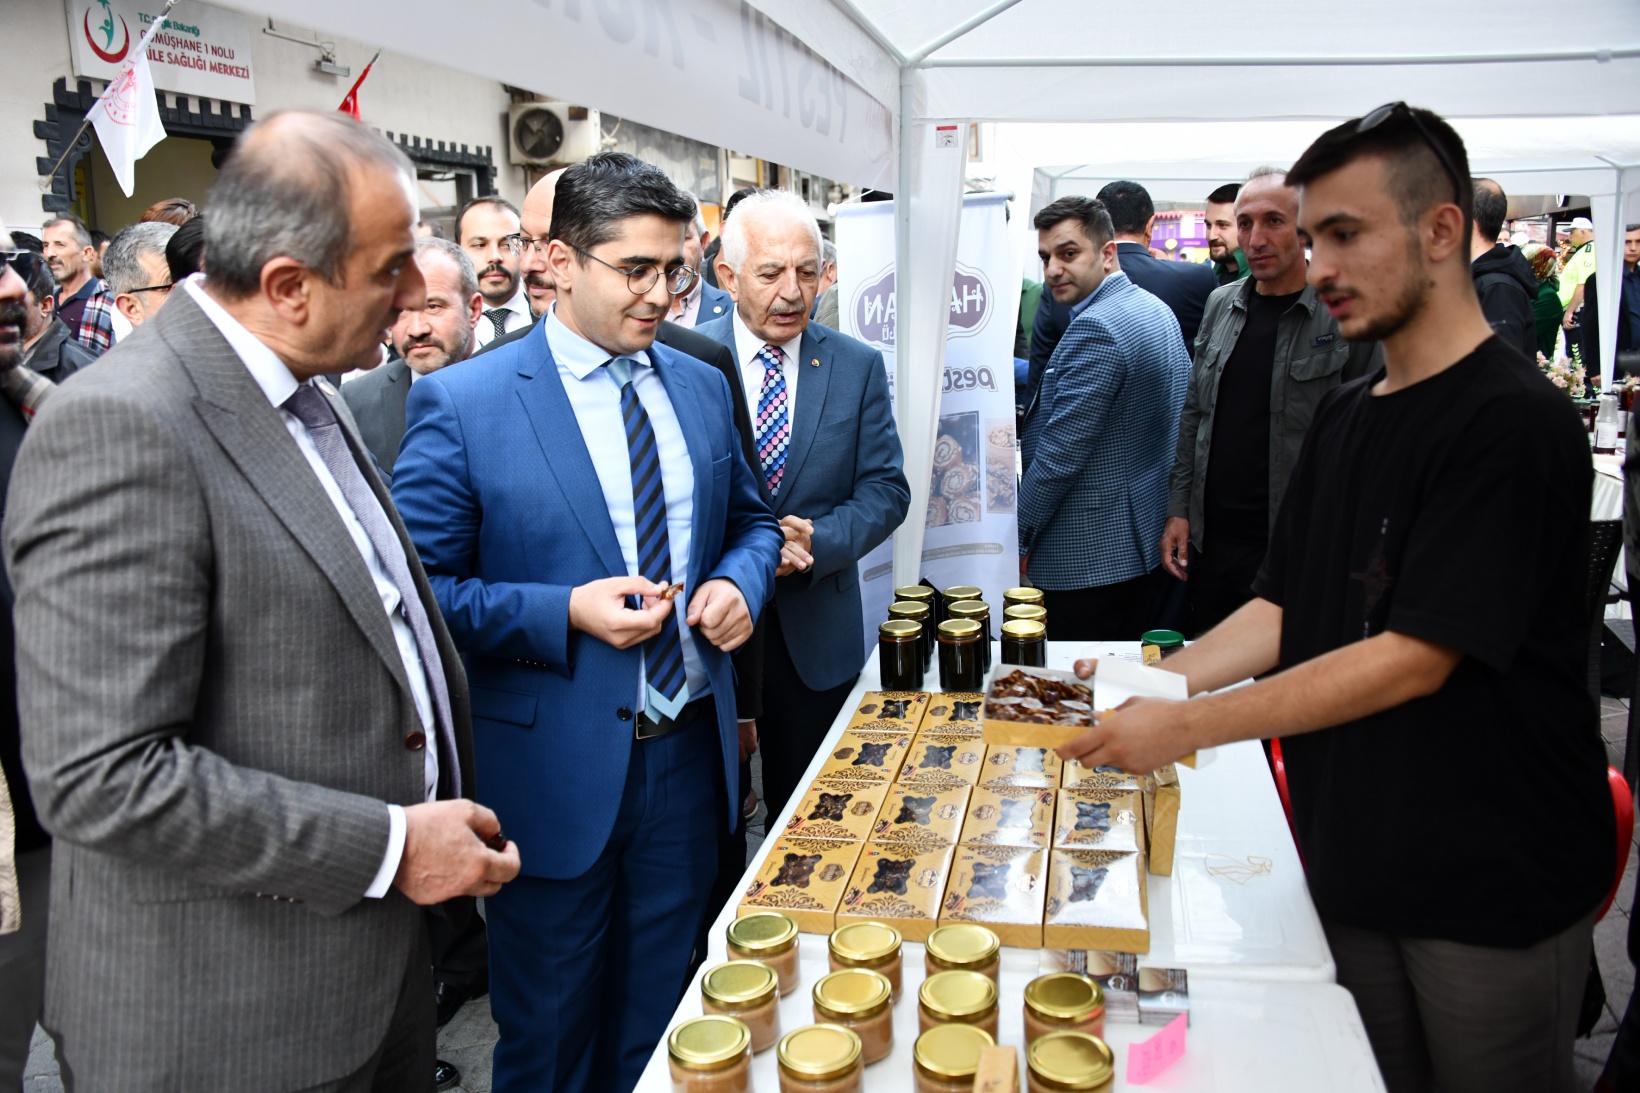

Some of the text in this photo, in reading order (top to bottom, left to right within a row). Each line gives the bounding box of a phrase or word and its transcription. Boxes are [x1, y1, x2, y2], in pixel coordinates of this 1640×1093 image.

[140, 29, 235, 60] GMÜŞHANE 1 NOLU
[167, 52, 207, 71] SAĞLIĞI
[209, 61, 250, 79] MERKEZİ
